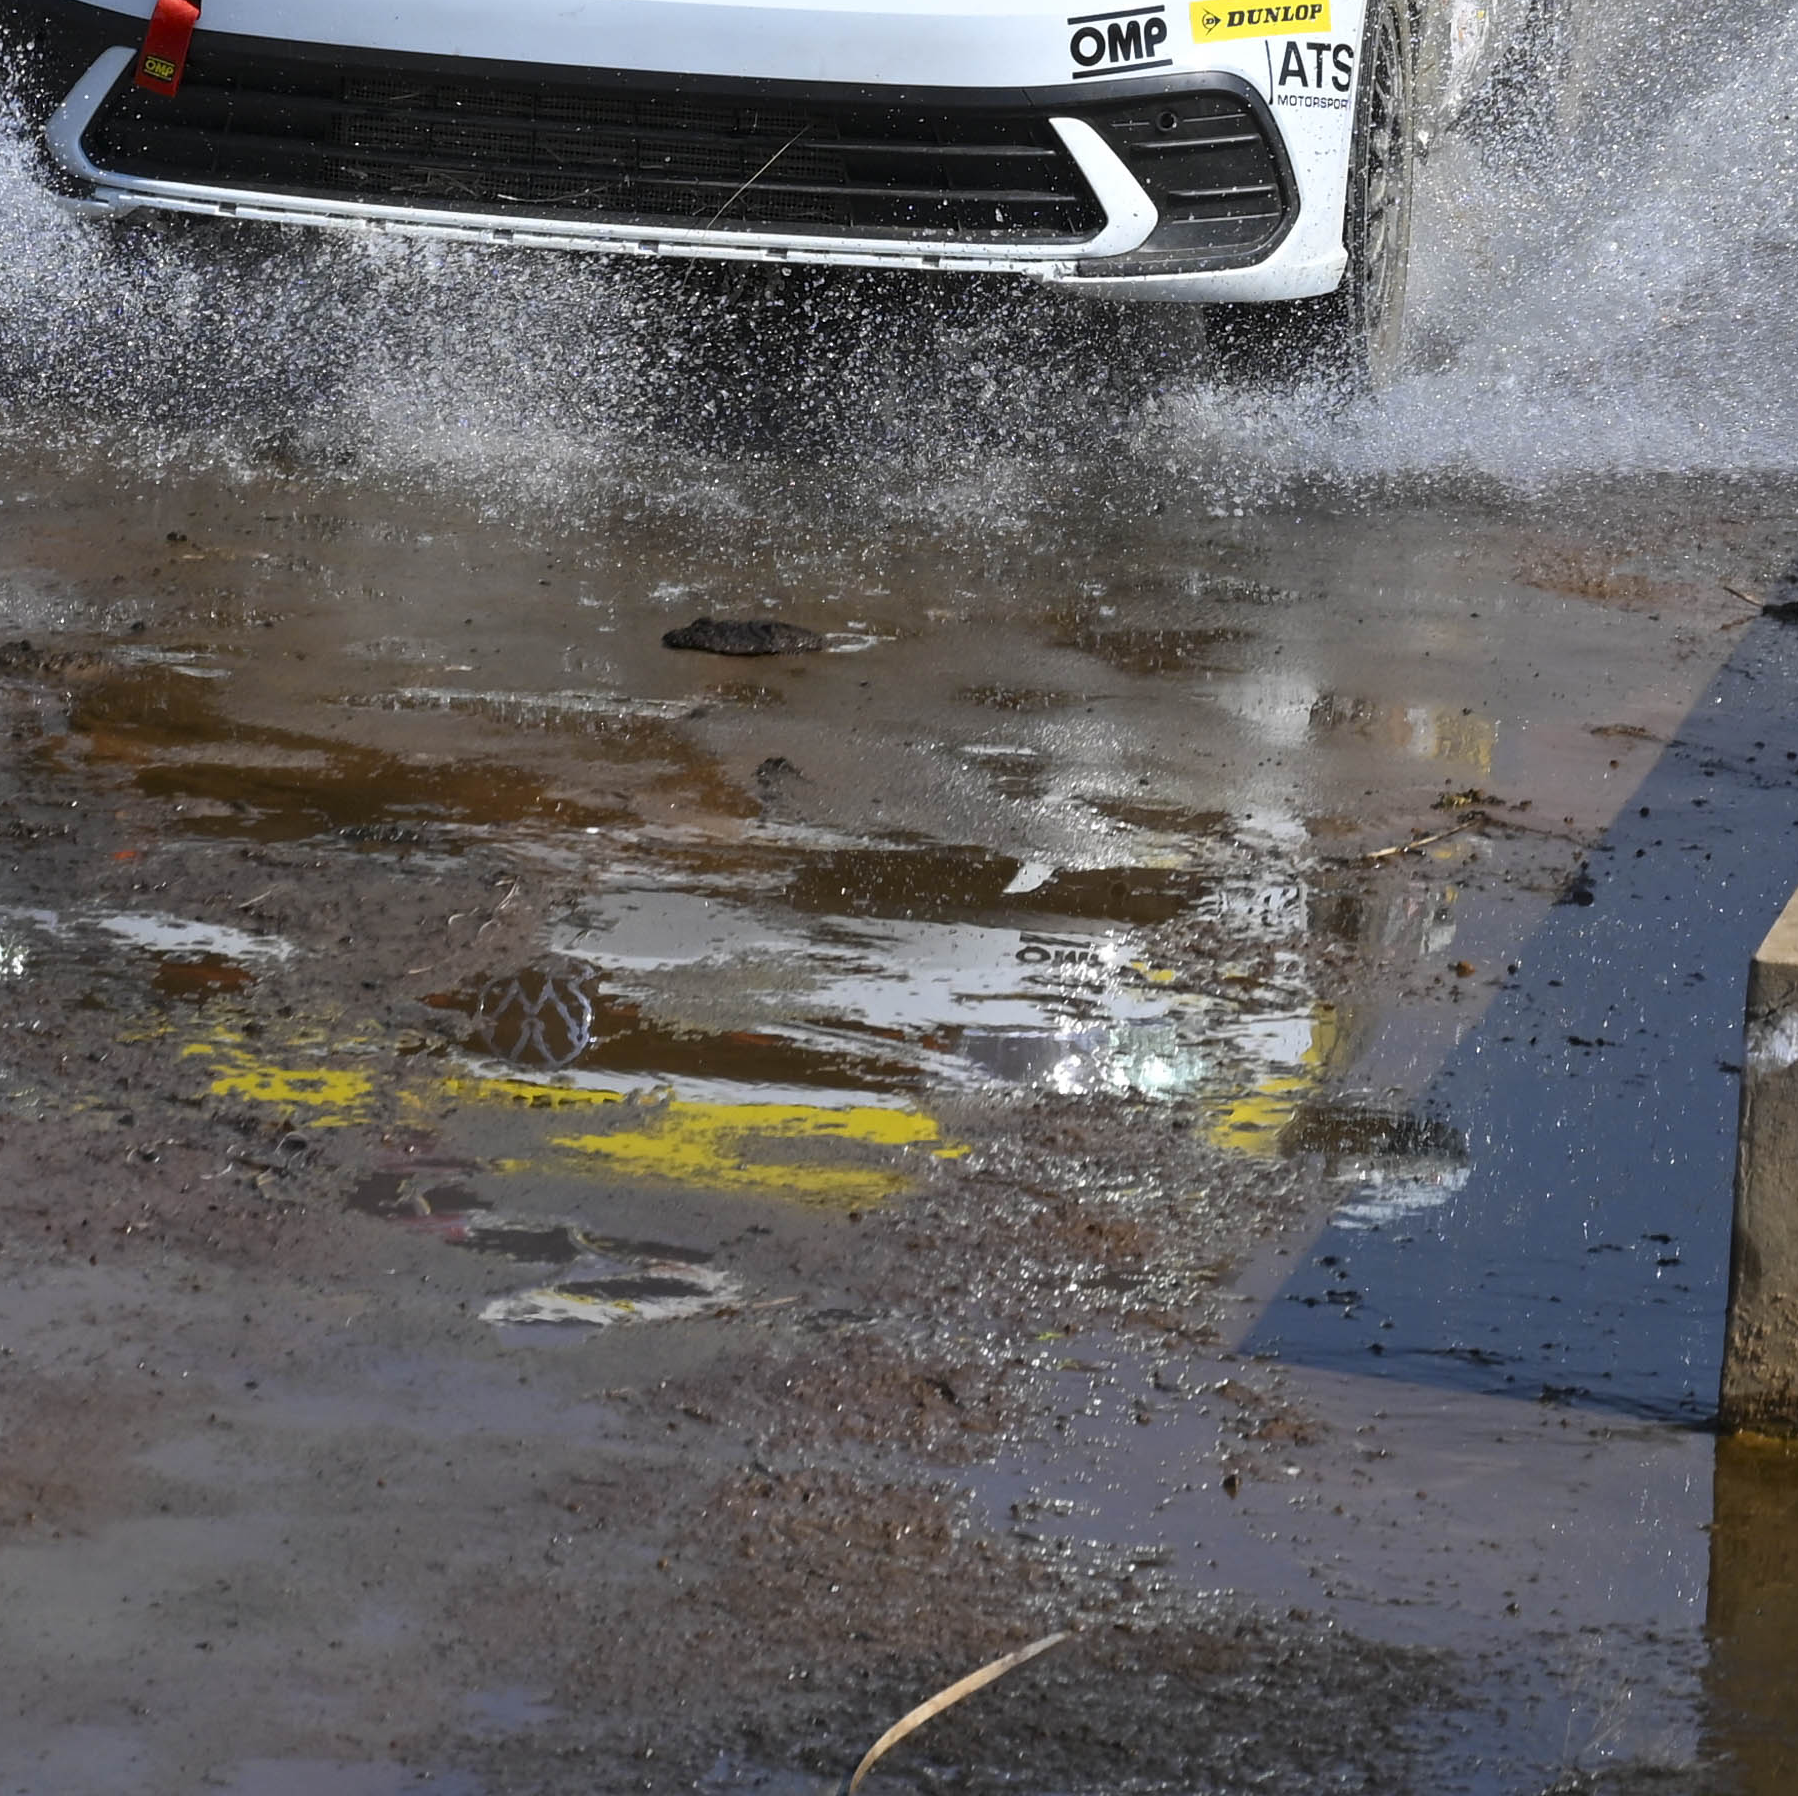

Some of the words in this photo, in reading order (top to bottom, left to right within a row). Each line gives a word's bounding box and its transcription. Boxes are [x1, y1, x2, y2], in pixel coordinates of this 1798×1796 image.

[1226, 3, 1324, 28] DUNLOP
[1069, 16, 1169, 67] OMP
[145, 59, 174, 77] OMP
[1278, 40, 1355, 93] ATS
[1277, 93, 1350, 110] MOTORSPOR
